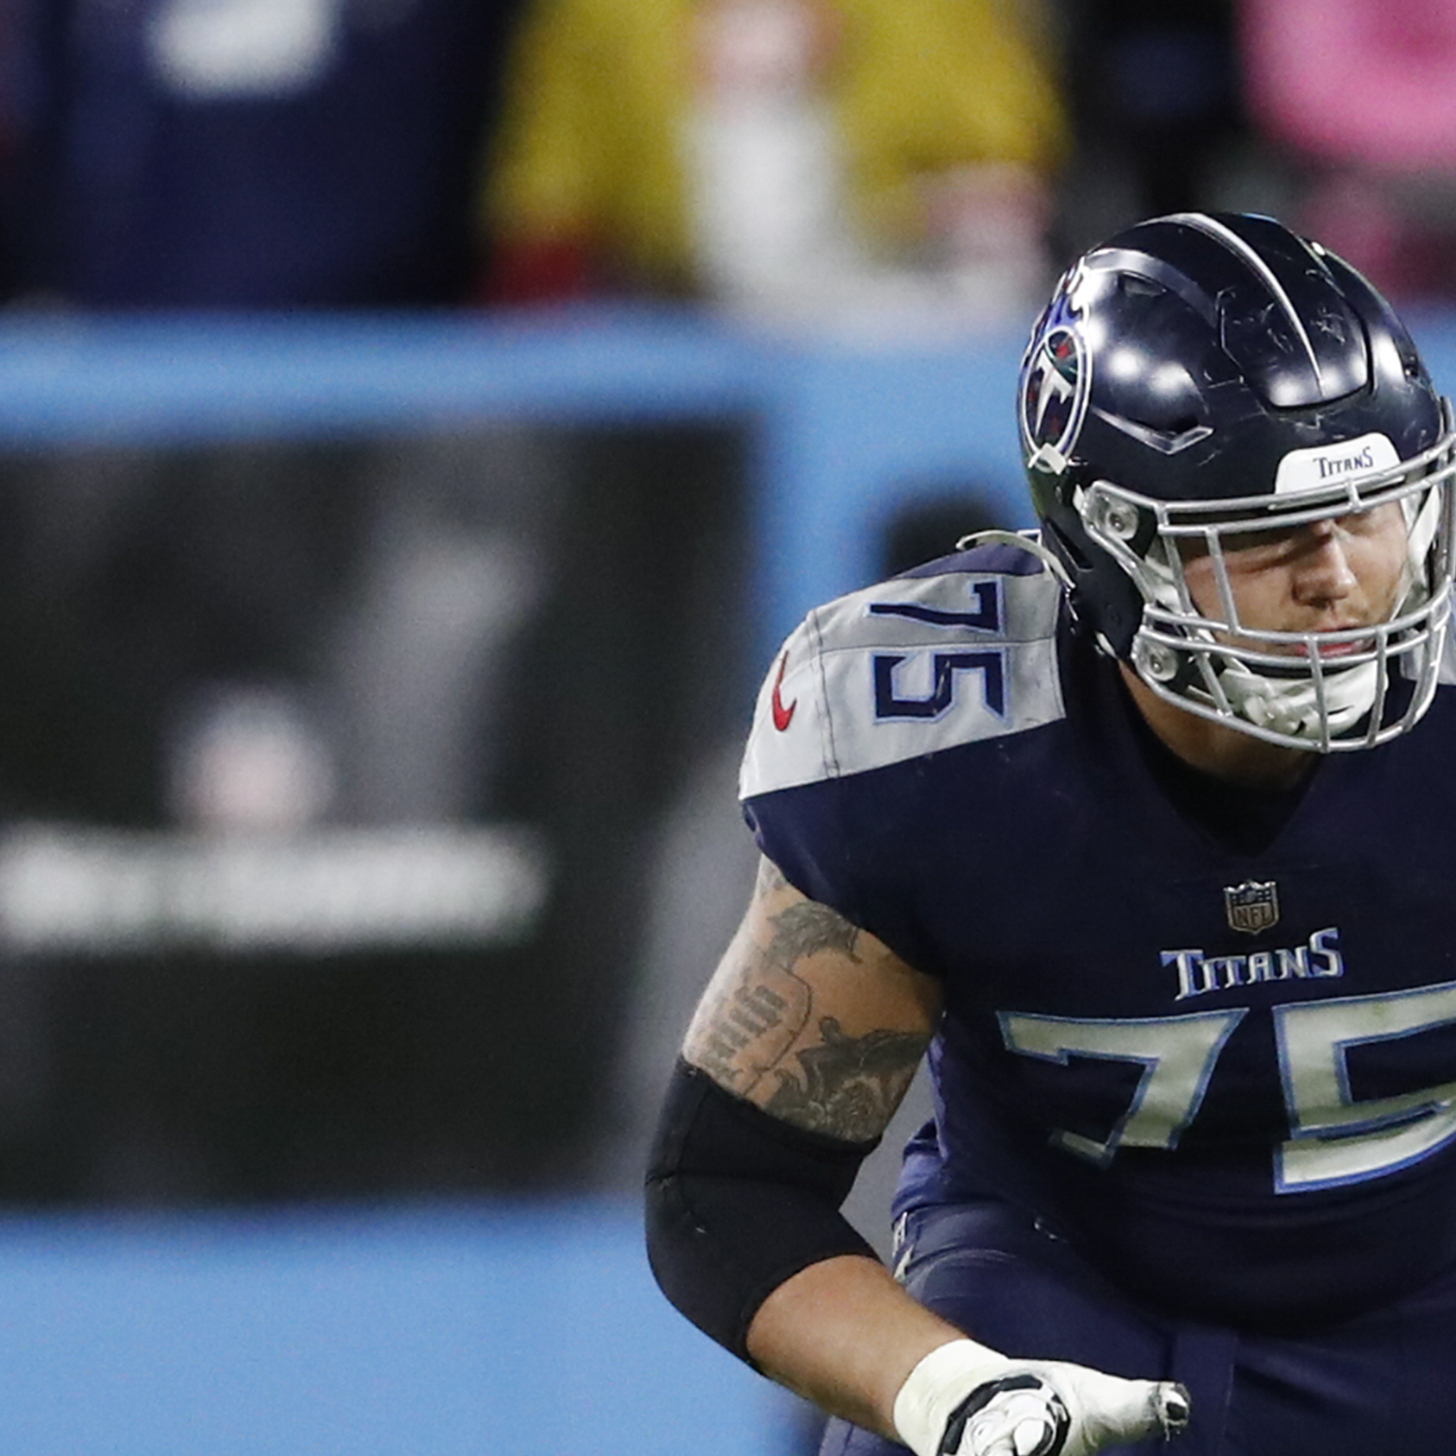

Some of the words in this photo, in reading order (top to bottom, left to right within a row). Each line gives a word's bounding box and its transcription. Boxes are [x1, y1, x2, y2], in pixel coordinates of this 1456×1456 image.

[863, 575, 1010, 726] 75
[1234, 904, 1272, 927] NFL
[1159, 927, 1346, 1001] TITANS
